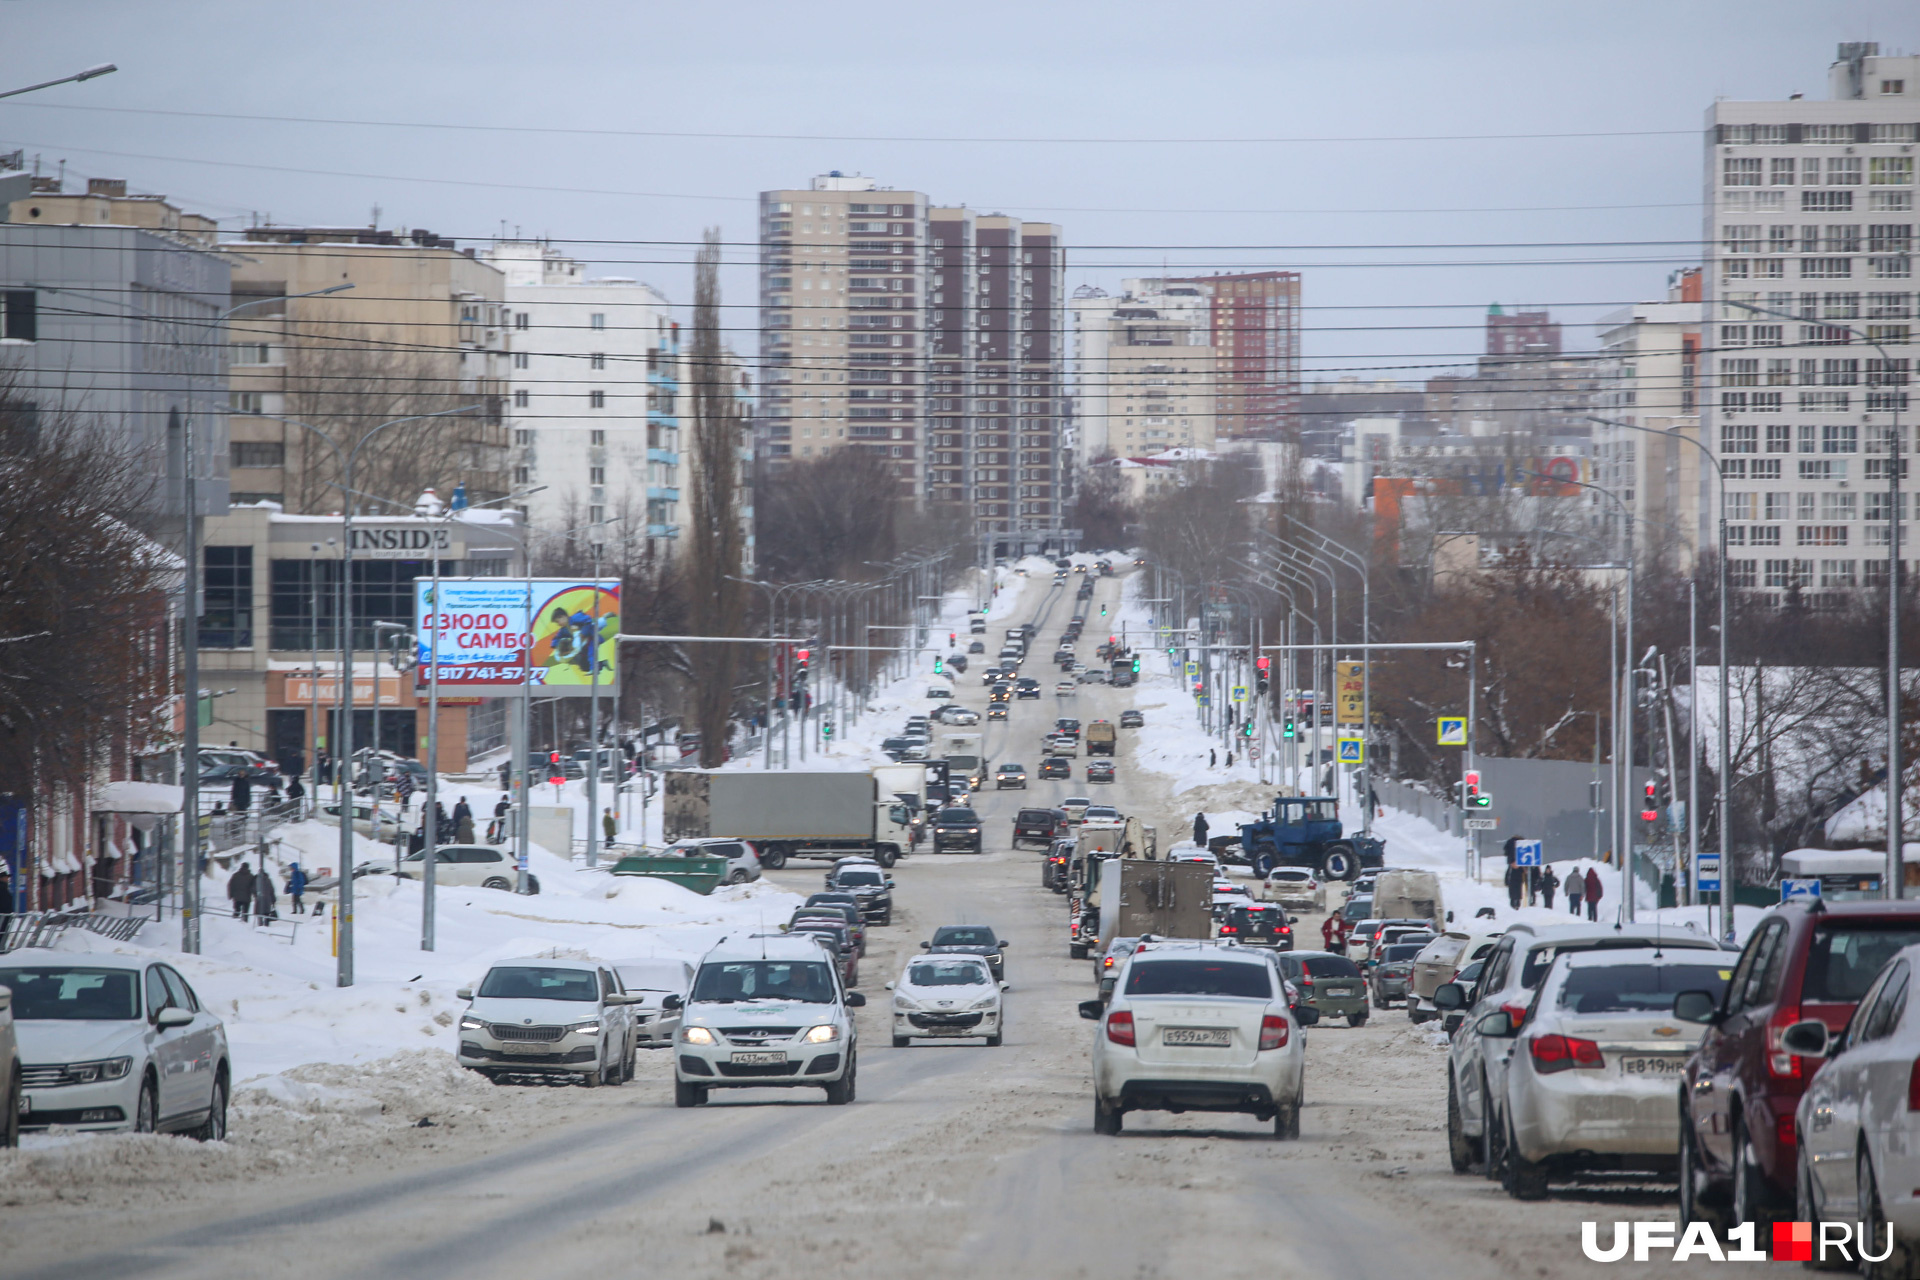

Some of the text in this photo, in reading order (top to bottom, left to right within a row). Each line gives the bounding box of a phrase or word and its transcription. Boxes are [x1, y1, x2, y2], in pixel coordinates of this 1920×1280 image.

[351, 529, 449, 549] INSIDE
[422, 613, 508, 630] ДЗЮДО
[457, 632, 535, 649] САМБО
